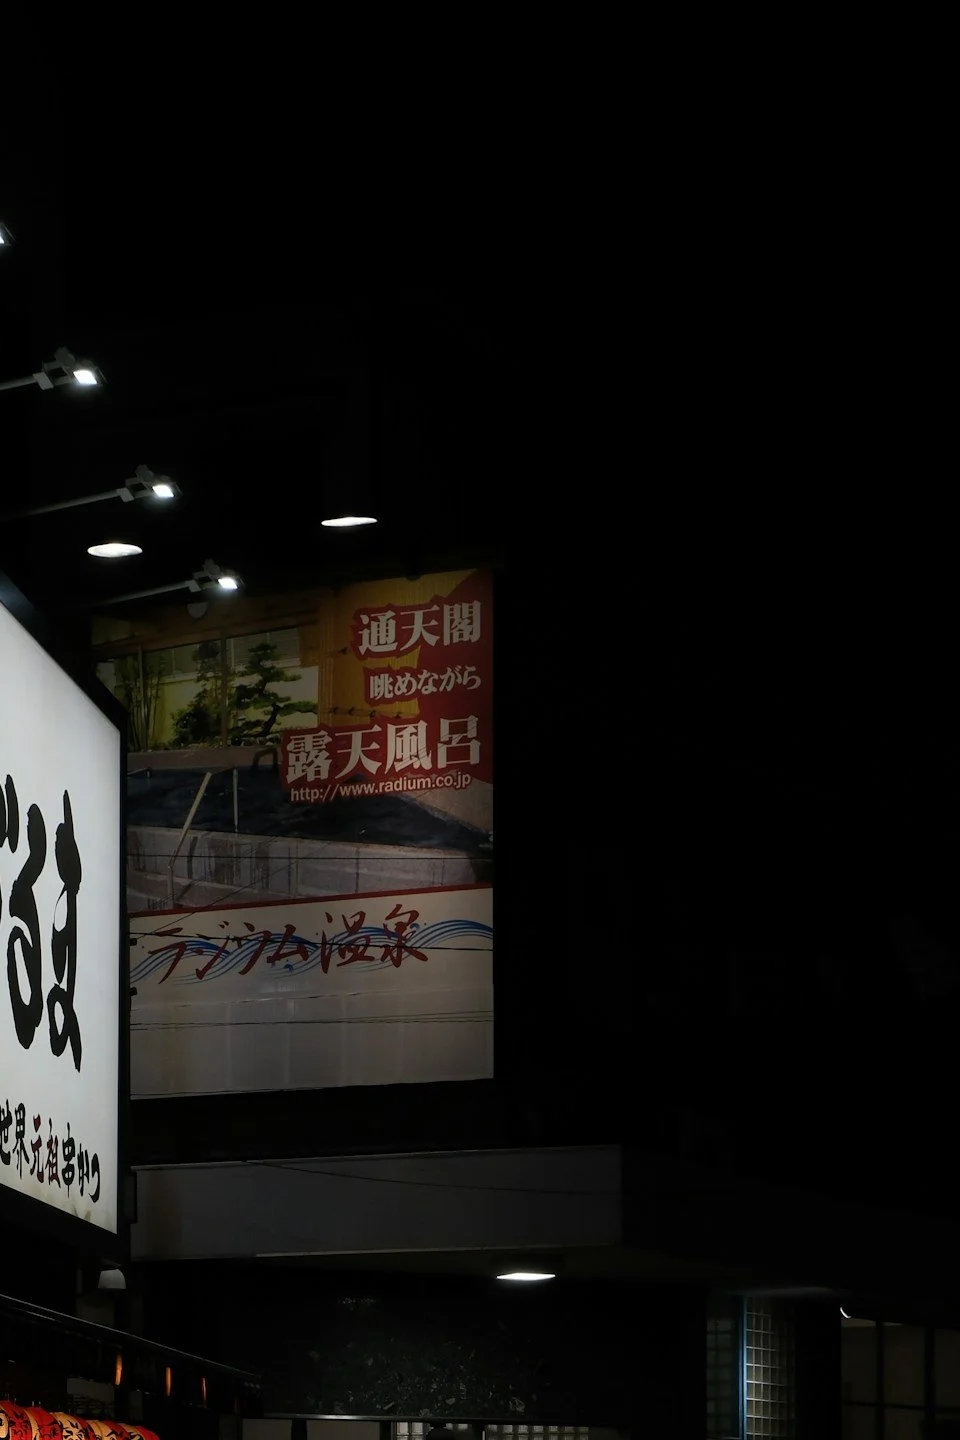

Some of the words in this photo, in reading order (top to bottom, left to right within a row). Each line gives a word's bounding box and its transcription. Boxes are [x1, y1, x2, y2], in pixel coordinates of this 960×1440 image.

[358, 600, 482, 656] 通天閣
[369, 665, 482, 700] 眺めながら
[285, 714, 481, 784] 露天風呂
[290, 771, 472, 804] http://www.radium.co.jp
[148, 903, 428, 984] ラジウム温泉
